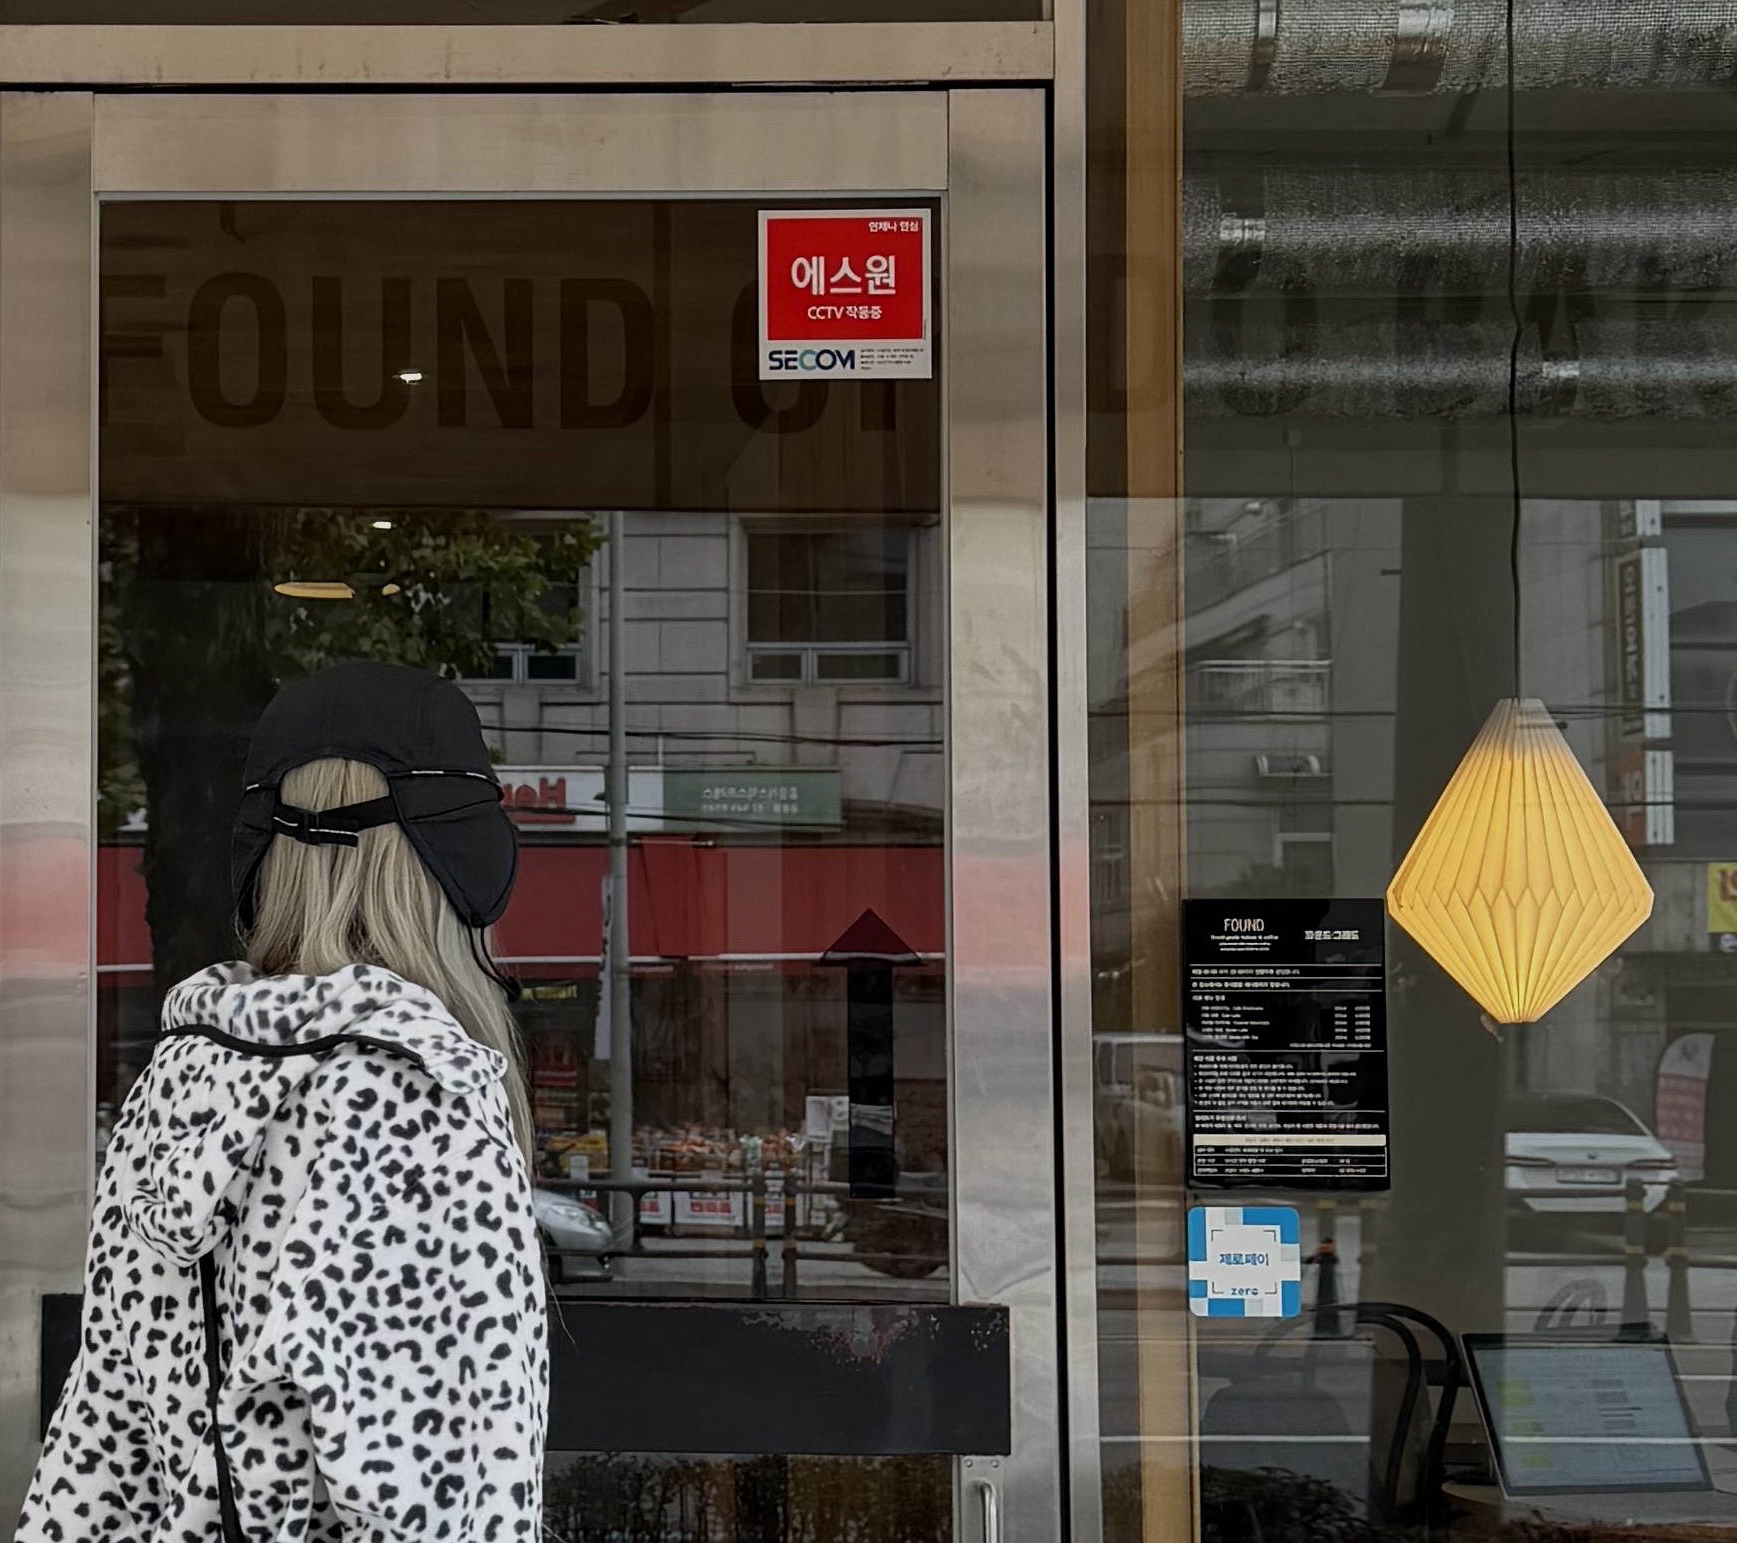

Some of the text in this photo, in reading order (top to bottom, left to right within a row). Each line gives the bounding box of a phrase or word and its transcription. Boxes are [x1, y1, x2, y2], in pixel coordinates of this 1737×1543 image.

[791, 255, 896, 296] 에스원
[807, 305, 882, 320] CCTV 작동중
[768, 349, 855, 370] SECOM
[1223, 918, 1265, 932] FOUND
